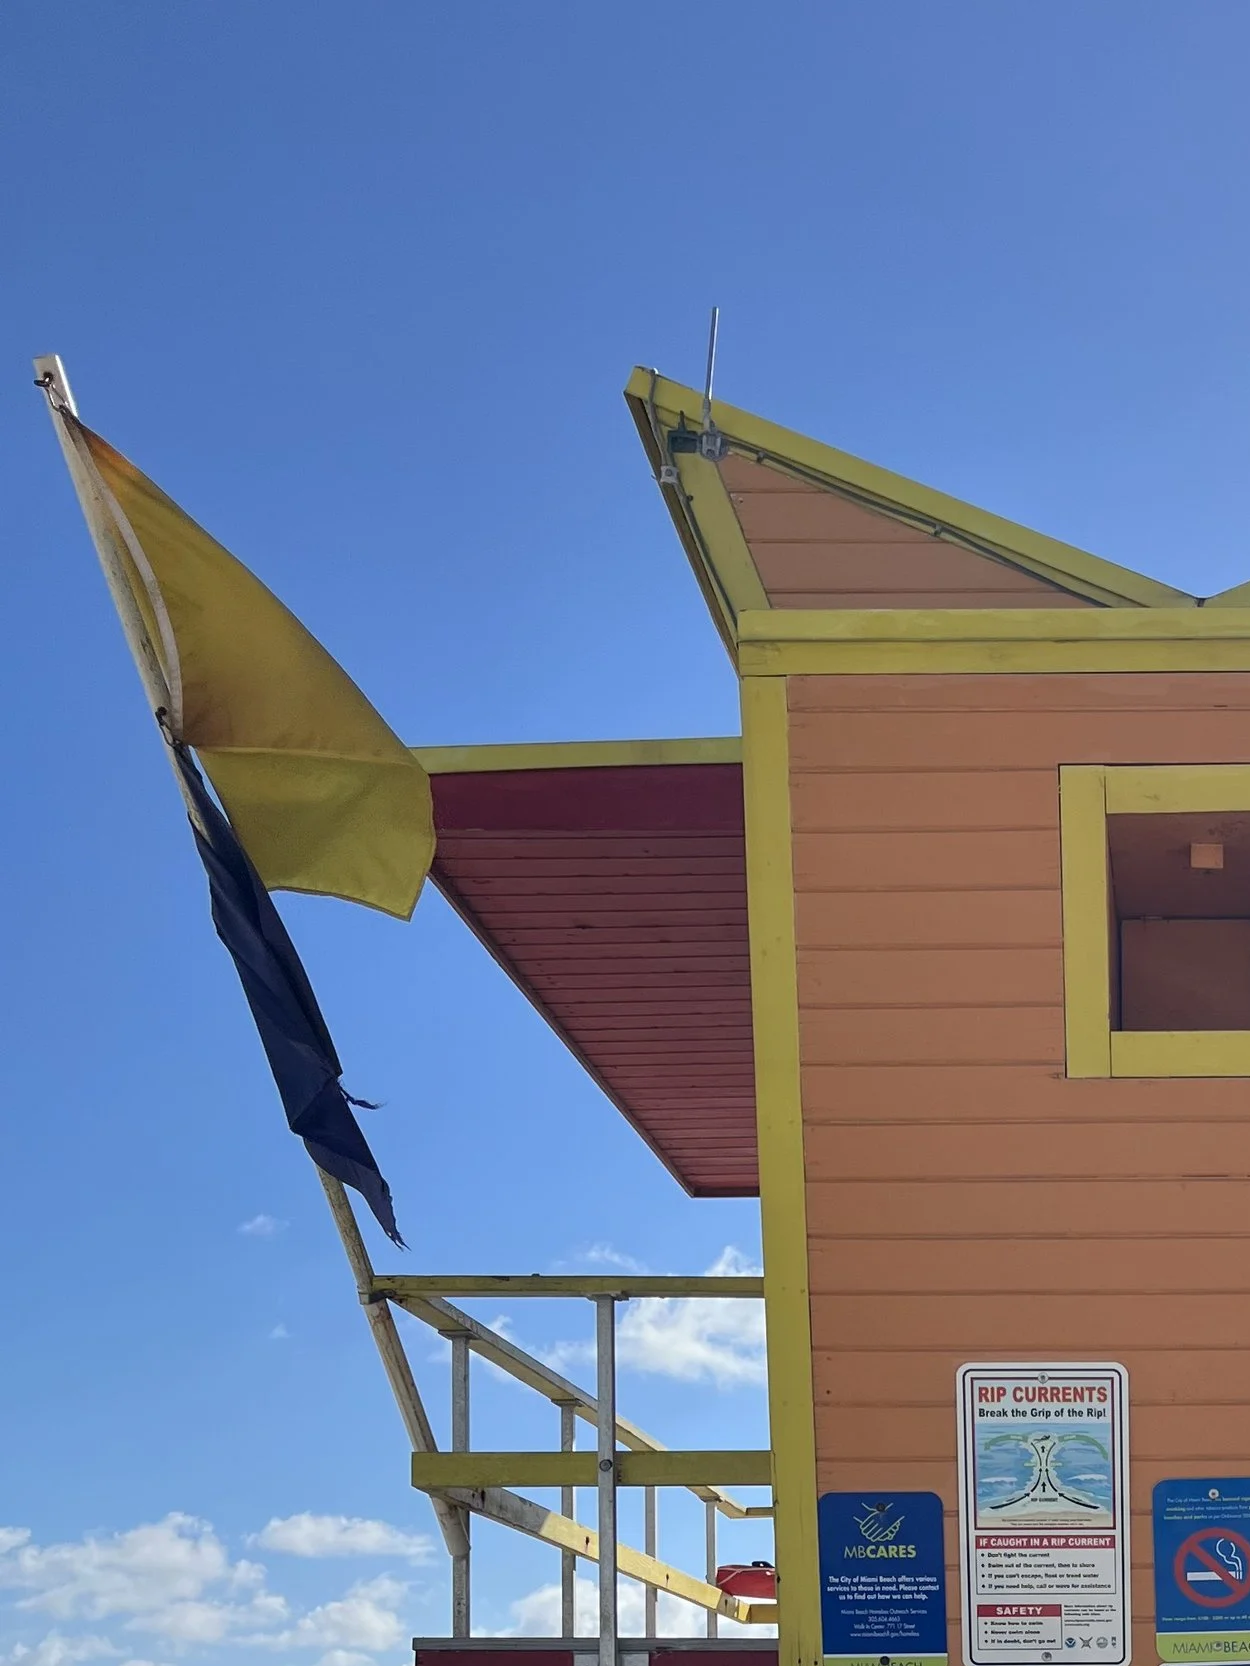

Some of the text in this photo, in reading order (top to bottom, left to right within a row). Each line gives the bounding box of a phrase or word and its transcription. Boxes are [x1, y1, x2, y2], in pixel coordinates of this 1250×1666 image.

[978, 1386, 1107, 1403] RIP CURRENTS
[979, 1408, 1106, 1419] Break the Grip of the Rip!
[980, 1538, 988, 1546] IF
[990, 1538, 1028, 1546] CAUGHT
[1051, 1538, 1066, 1546] RIP
[1068, 1538, 1111, 1546] CURRENT
[844, 1545, 916, 1558] MBCARES
[840, 1576, 851, 1584] City
[879, 1576, 897, 1585] Beach
[898, 1575, 914, 1585] offers
[996, 1607, 1042, 1615] SAFETY
[1172, 1642, 1213, 1654] MIAMI
